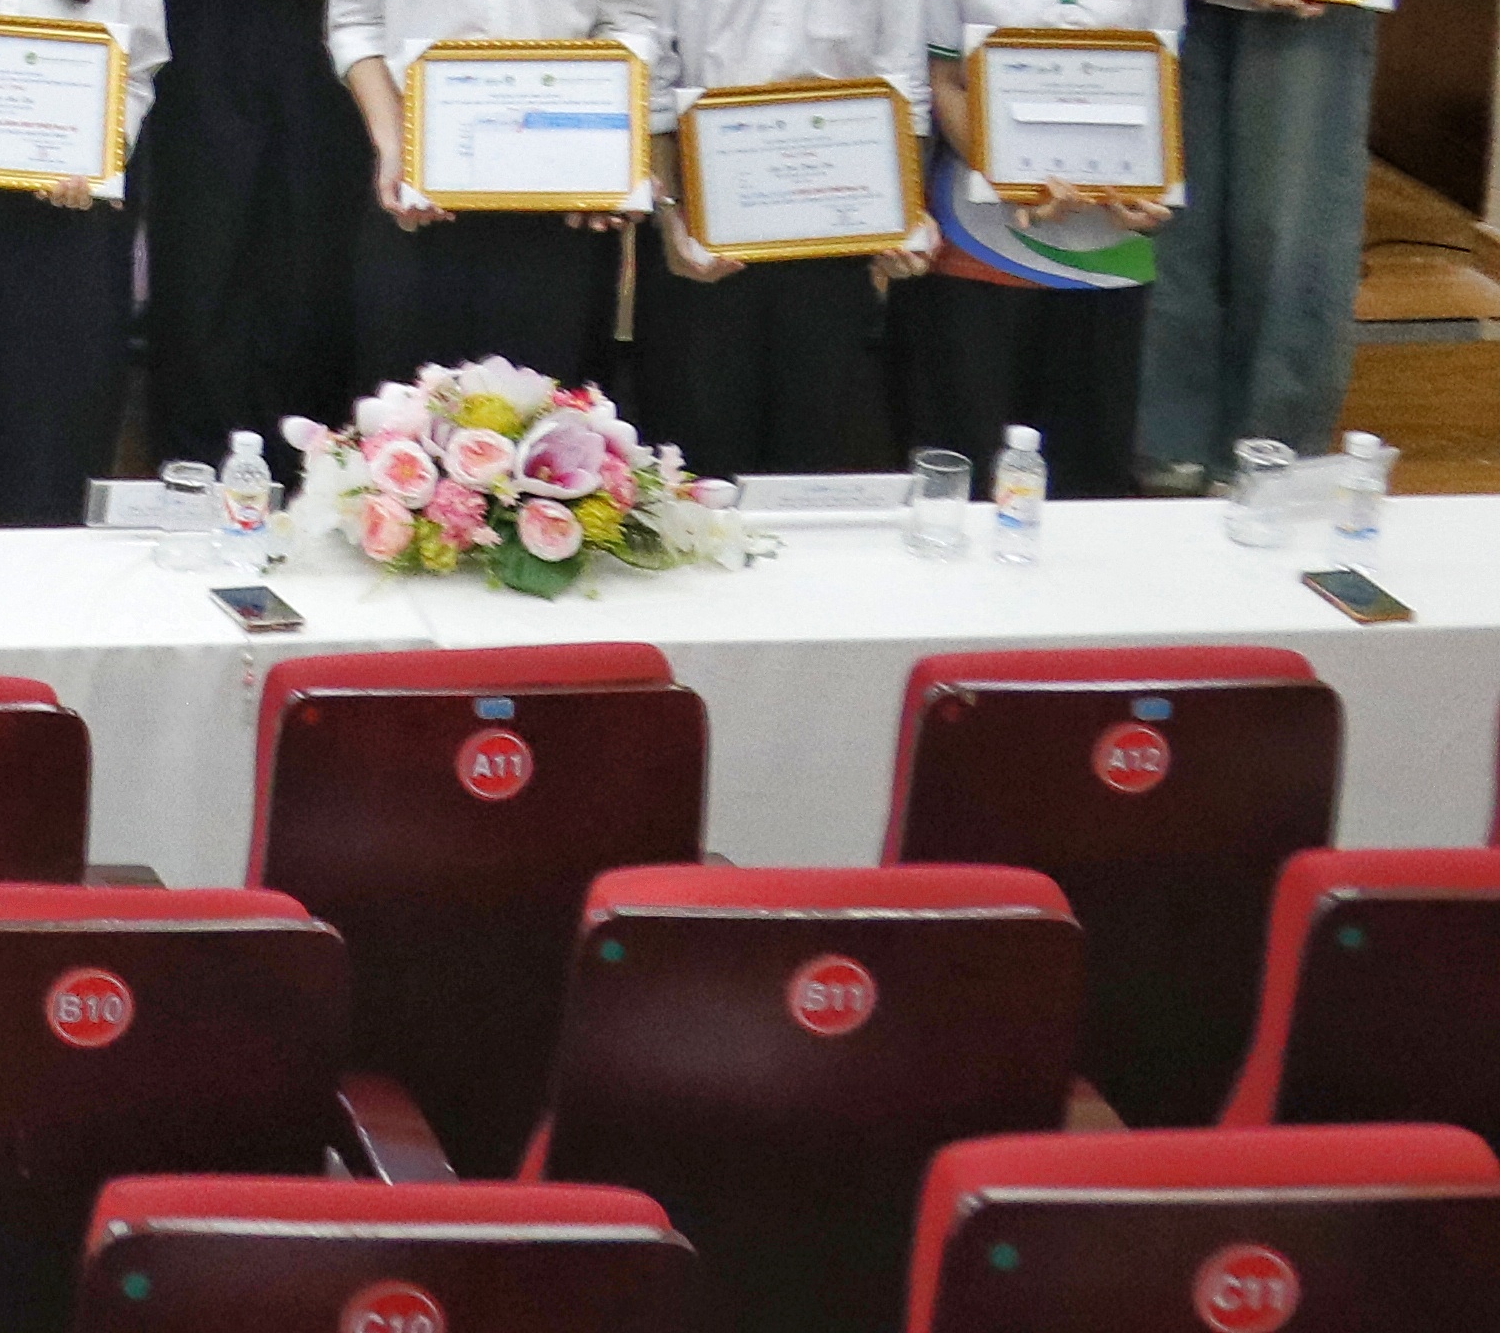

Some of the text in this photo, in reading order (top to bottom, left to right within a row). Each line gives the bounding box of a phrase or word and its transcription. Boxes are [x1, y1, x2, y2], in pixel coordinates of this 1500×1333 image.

[469, 752, 521, 779] A11
[1107, 746, 1162, 772] A12
[55, 992, 122, 1023] B10
